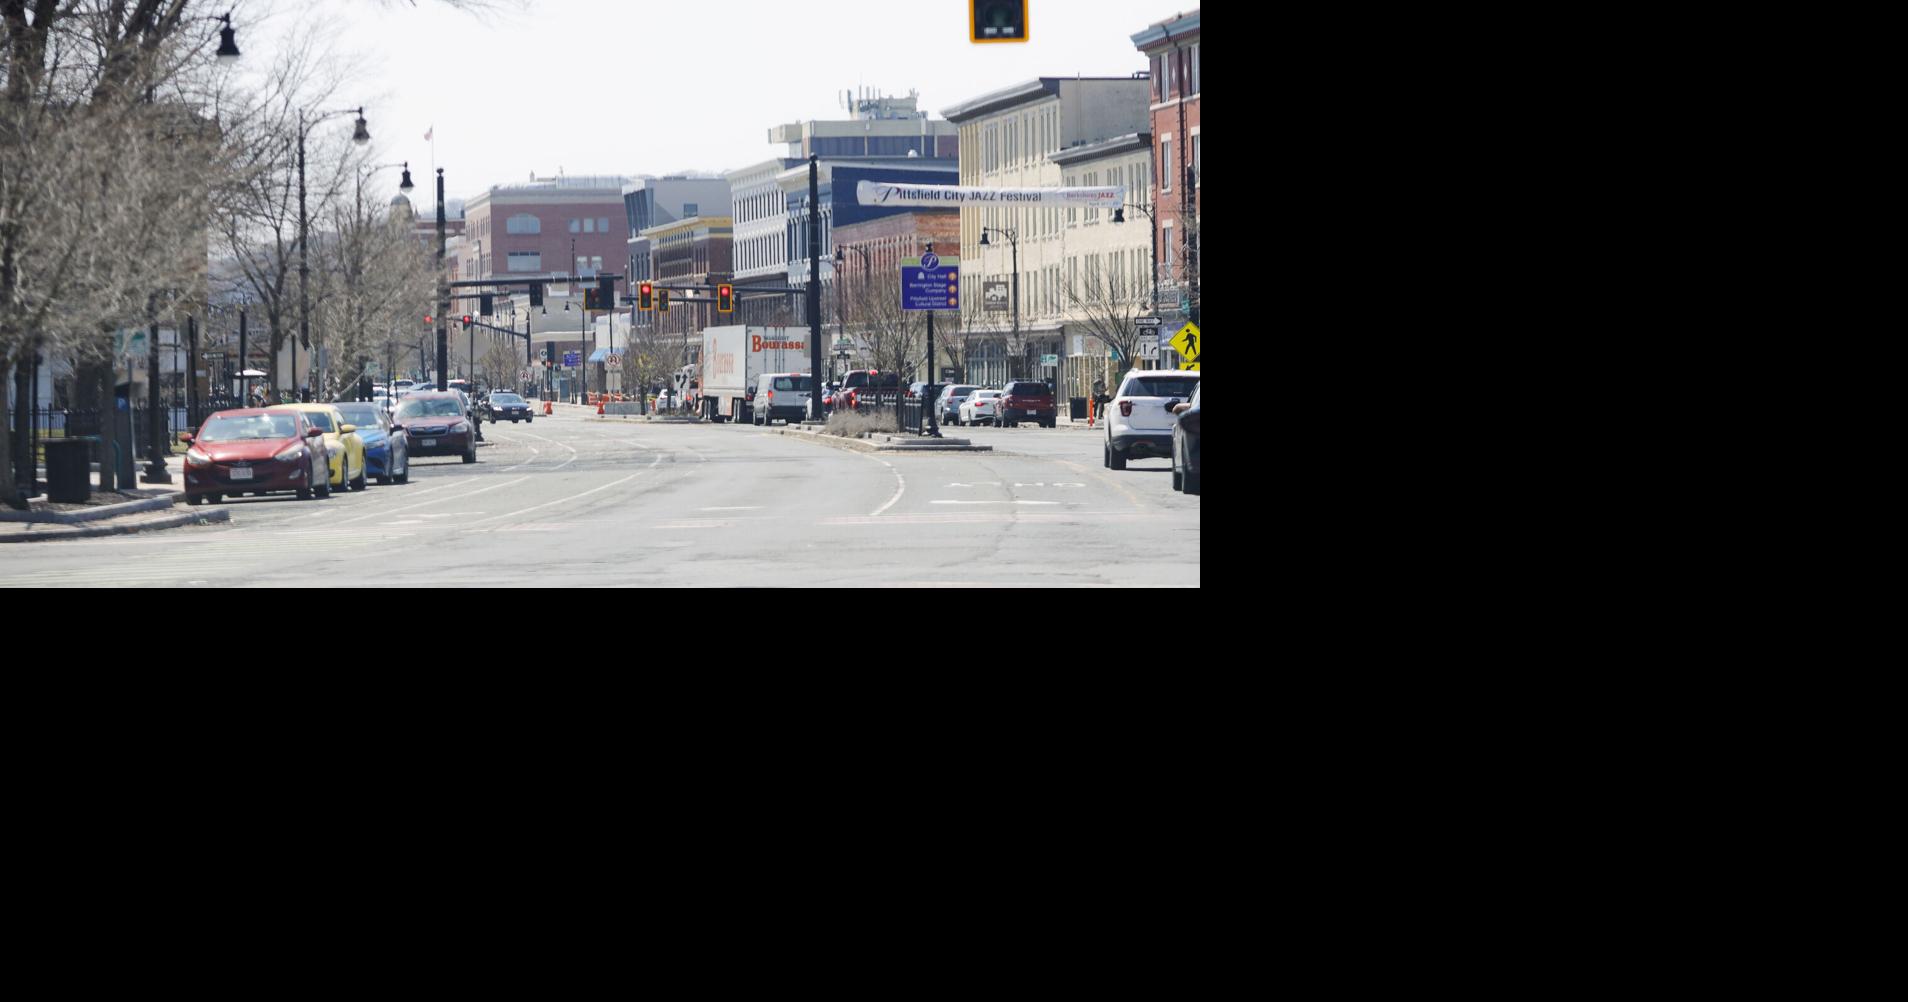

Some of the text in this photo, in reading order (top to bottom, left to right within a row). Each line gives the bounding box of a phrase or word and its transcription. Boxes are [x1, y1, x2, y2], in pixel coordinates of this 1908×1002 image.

[877, 187, 1042, 203] Pittsfield City JAZZ Festival
